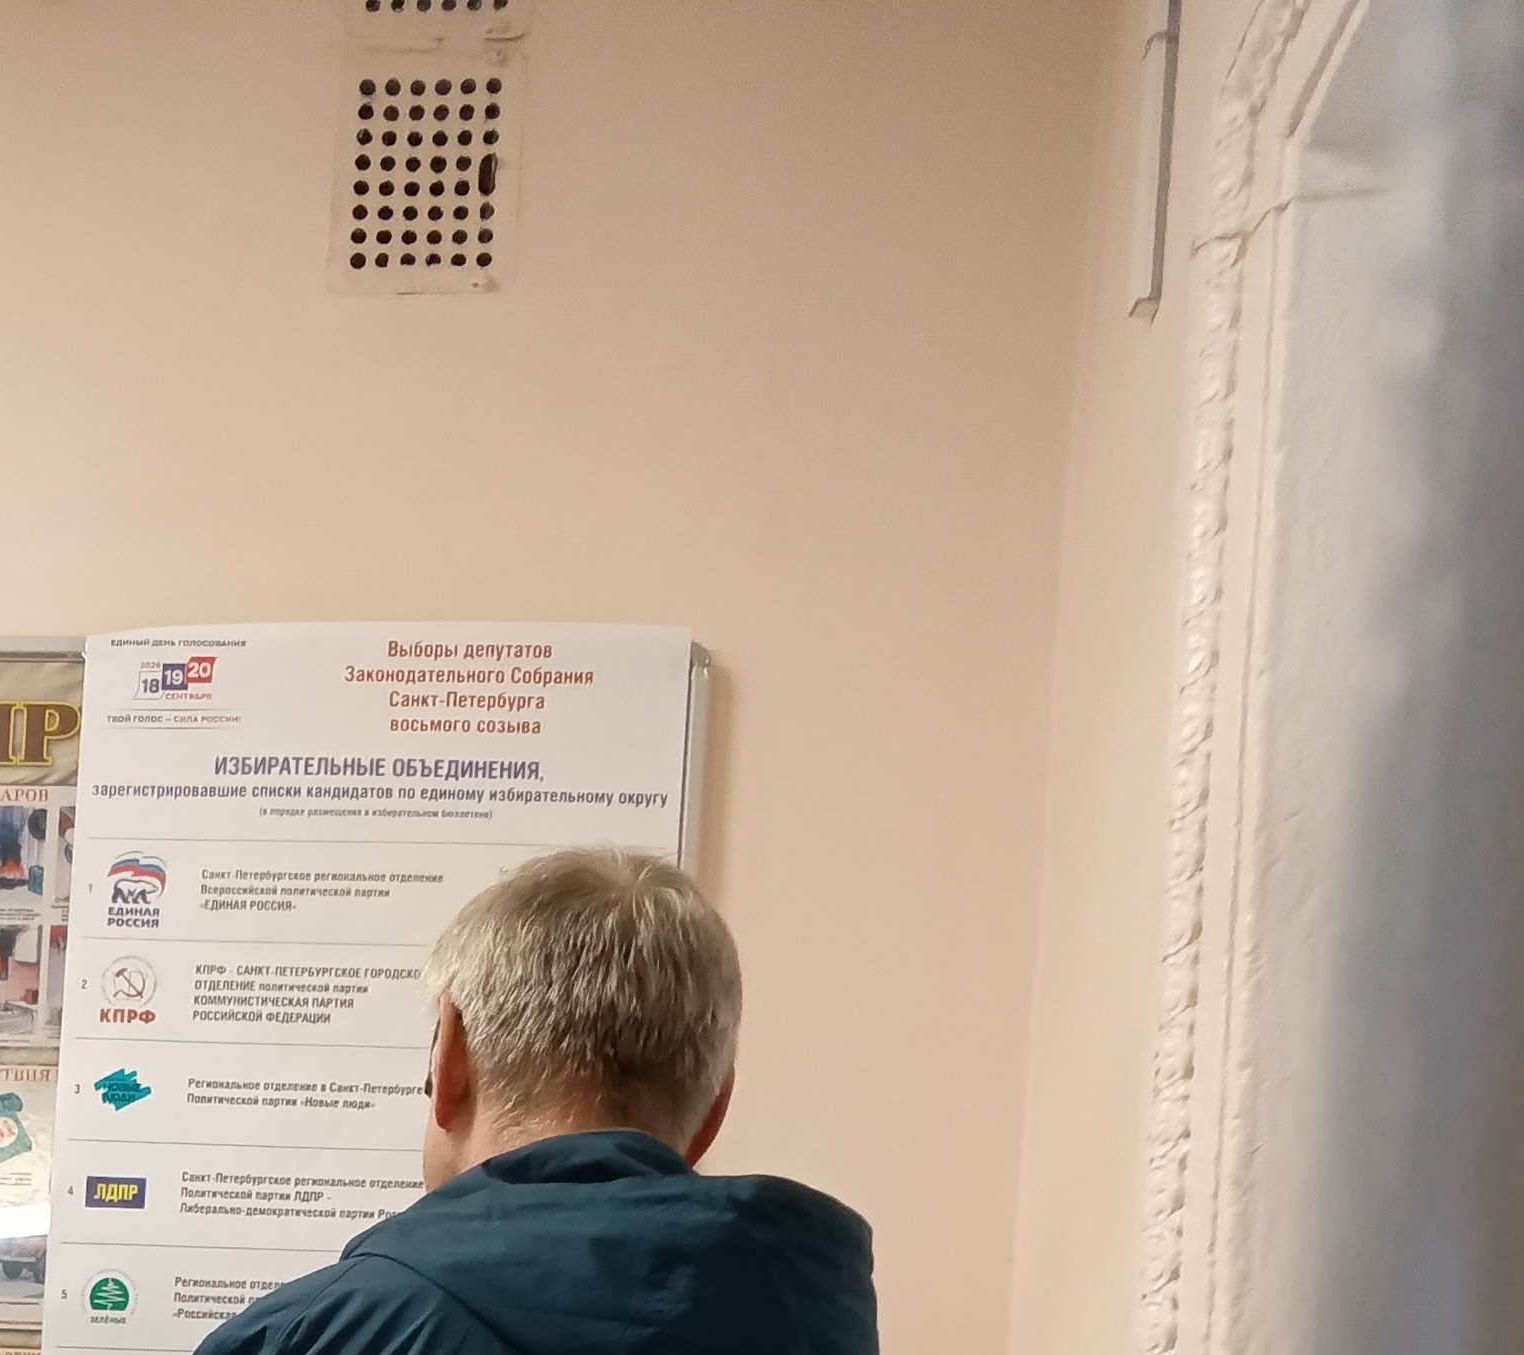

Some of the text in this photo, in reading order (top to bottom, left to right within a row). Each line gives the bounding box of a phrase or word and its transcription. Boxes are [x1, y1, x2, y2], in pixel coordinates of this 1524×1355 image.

[110, 638, 247, 647] ЕДИНЫЙ ДЕНЬ ГОЛОСОВАНИЯ
[387, 640, 553, 662] Выборы депутатов
[141, 662, 211, 693] 18 19 20
[344, 665, 594, 688] Законодательного Собрания
[389, 690, 545, 712] Санкт-Петербурга
[107, 714, 132, 723] ТВОЙ
[133, 715, 163, 723] ГОЛОС
[173, 715, 199, 723] СИЛА
[390, 718, 542, 734] восьмого созыва
[214, 756, 545, 783] ИЗБИРАТЕЛЬНЫЕ ОБЪЕДИНЕНИЯ,
[91, 783, 668, 808] зарегистрировавшие списки кандидатов по единому избирательному округу
[270, 808, 493, 819] порядке размещения избирательном бюллетене)
[201, 869, 444, 884] Санкт-Петербургское региональное отделение
[200, 884, 391, 899] Всероссийской политической партии
[200, 900, 297, 912] «ЕДИНАЯ РОССИЯ»
[107, 907, 160, 928] ЕДИНАЯ РОССИЯ
[196, 964, 361, 979] КПРФ САНКТ-ПЕТЕРБУРГСКОЕ
[81, 979, 88, 990] 2
[194, 979, 369, 994] ОТДЕЛЕНИЕ политической партии
[193, 994, 354, 1009] КОММУНИСТИЧЕСКАЯ ПАРТИЯ
[100, 1008, 156, 1024] КПРФ
[192, 1009, 331, 1025] РОССИЙСКОЙ ФЕДЕРАЦИИ
[74, 1084, 81, 1094] 3
[187, 1078, 261, 1091] Региональное
[263, 1080, 318, 1092] отделение
[329, 1082, 423, 1097] Санкт-Петербурге
[187, 1093, 376, 1110] Политической партии «Новые люди»
[181, 1171, 425, 1189] Санкт-Петербургское региональное отделение
[67, 1185, 74, 1195] 4
[93, 1183, 139, 1203] ЛДПР
[180, 1187, 324, 1203] Политической партии ЛДПР
[179, 1203, 375, 1220] Либерально-демократической партии
[174, 1276, 247, 1290] Региональное
[61, 1289, 67, 1299] 5
[173, 1292, 245, 1305] Политической
